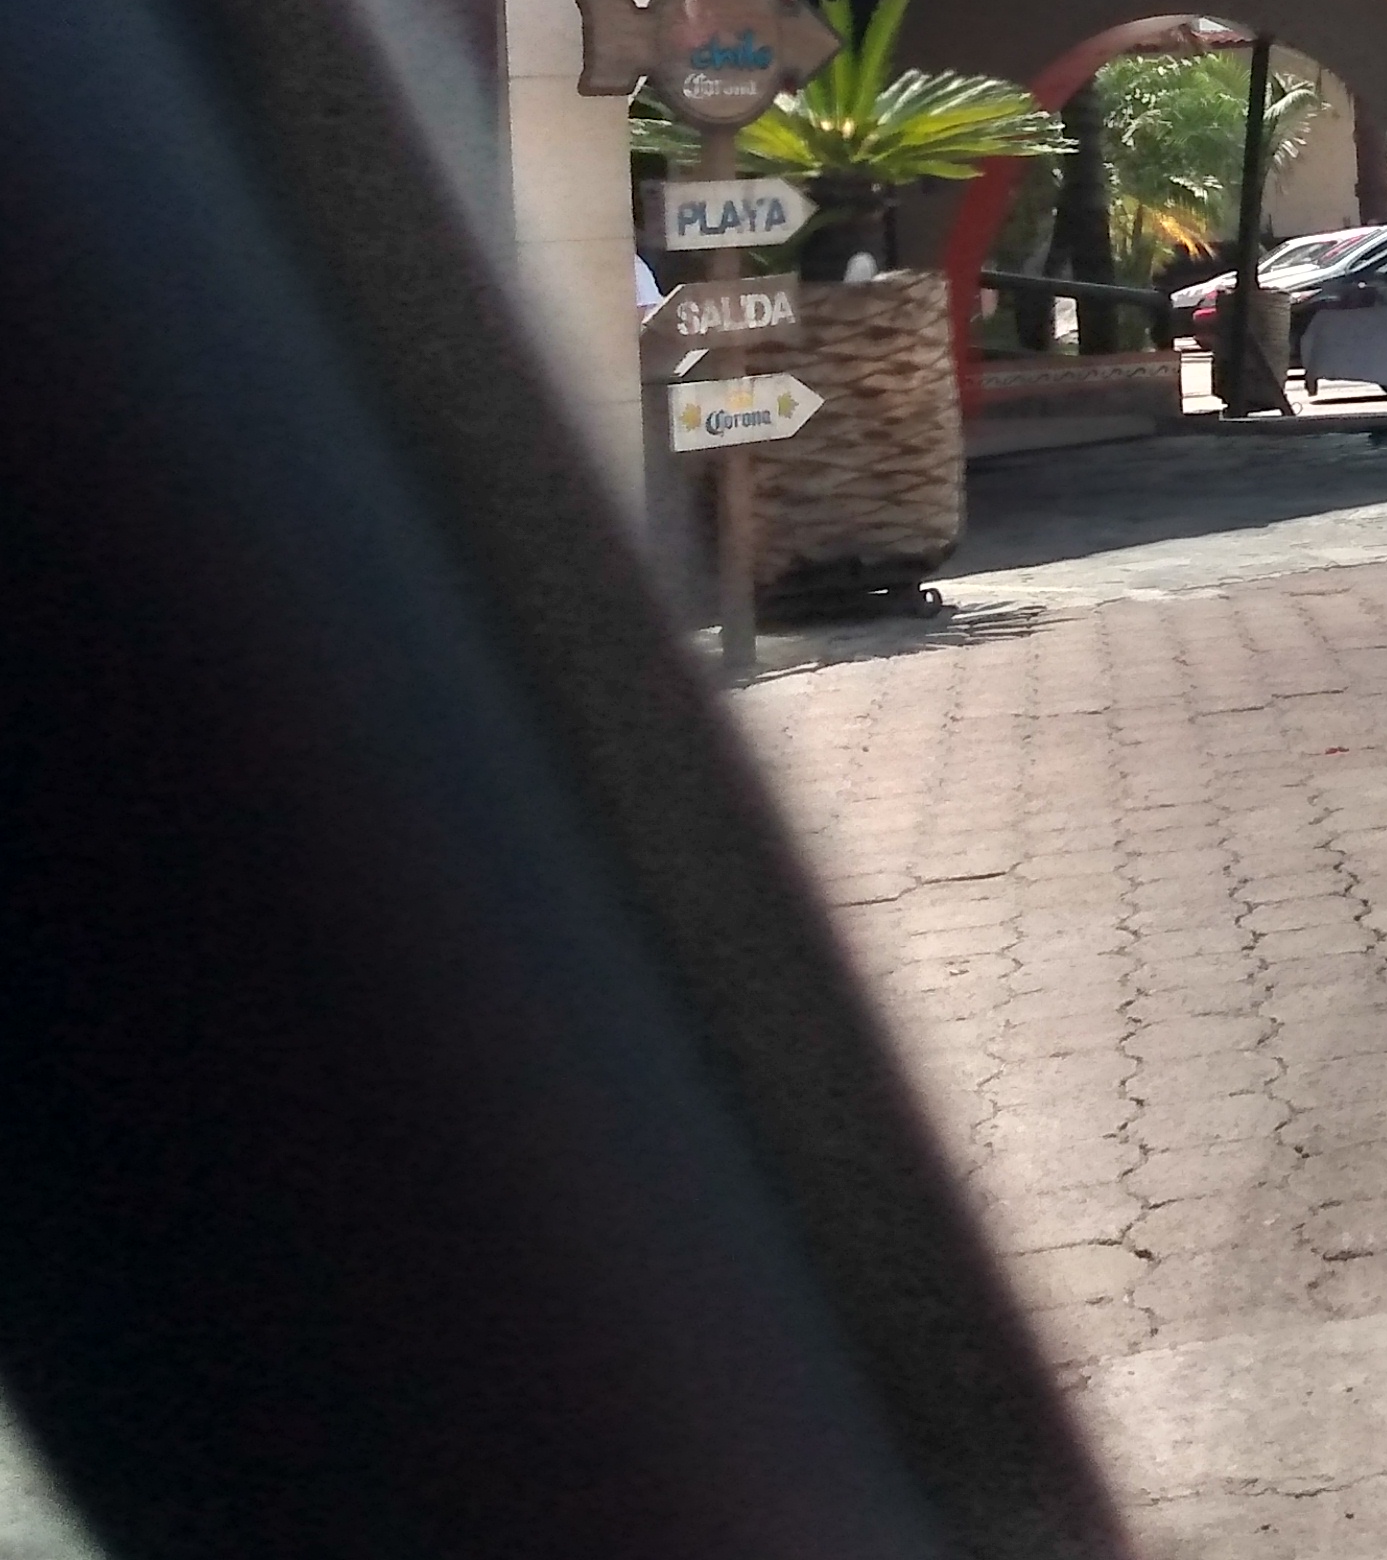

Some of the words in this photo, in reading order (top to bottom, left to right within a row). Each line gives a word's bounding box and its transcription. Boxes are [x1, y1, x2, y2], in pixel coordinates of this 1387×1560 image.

[677, 198, 787, 236] PLAYA
[676, 291, 797, 336] SALIDA
[705, 408, 772, 438] Corona
